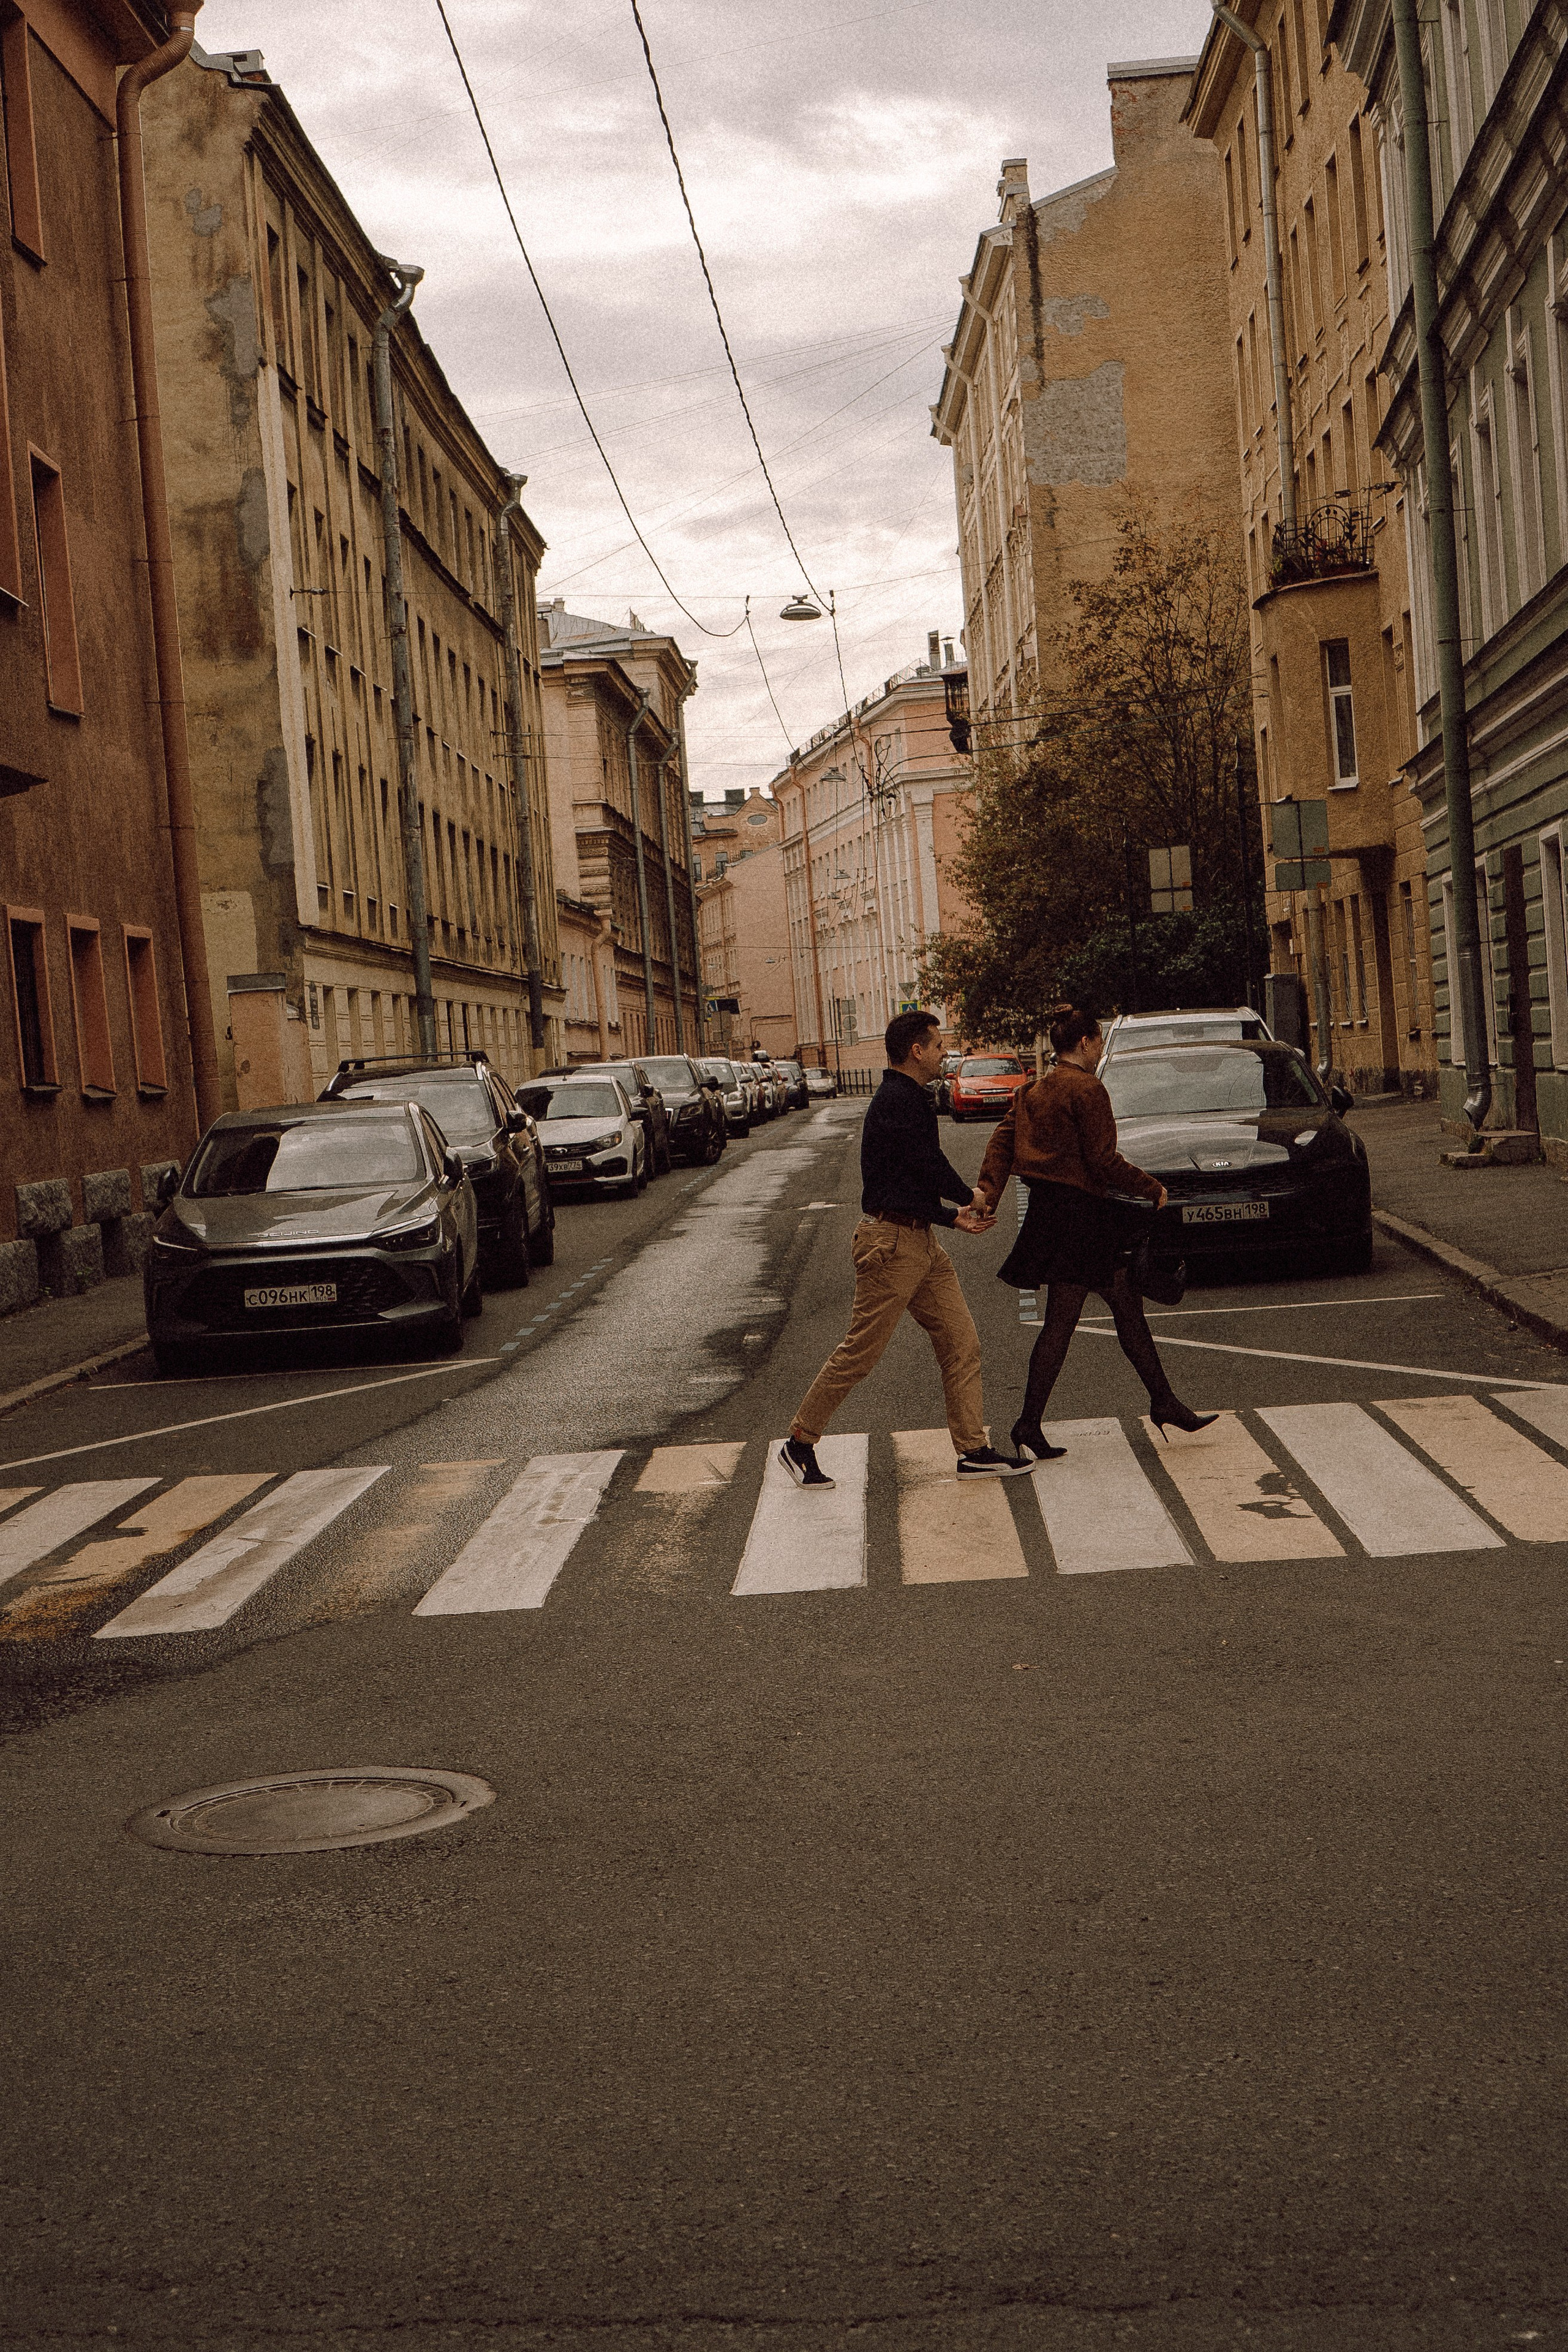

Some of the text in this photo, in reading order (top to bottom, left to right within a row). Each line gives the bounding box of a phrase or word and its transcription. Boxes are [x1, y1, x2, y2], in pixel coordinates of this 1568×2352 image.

[1186, 1202, 1266, 1222] У465ВН 198
[248, 1284, 333, 1306] С096НК 198
